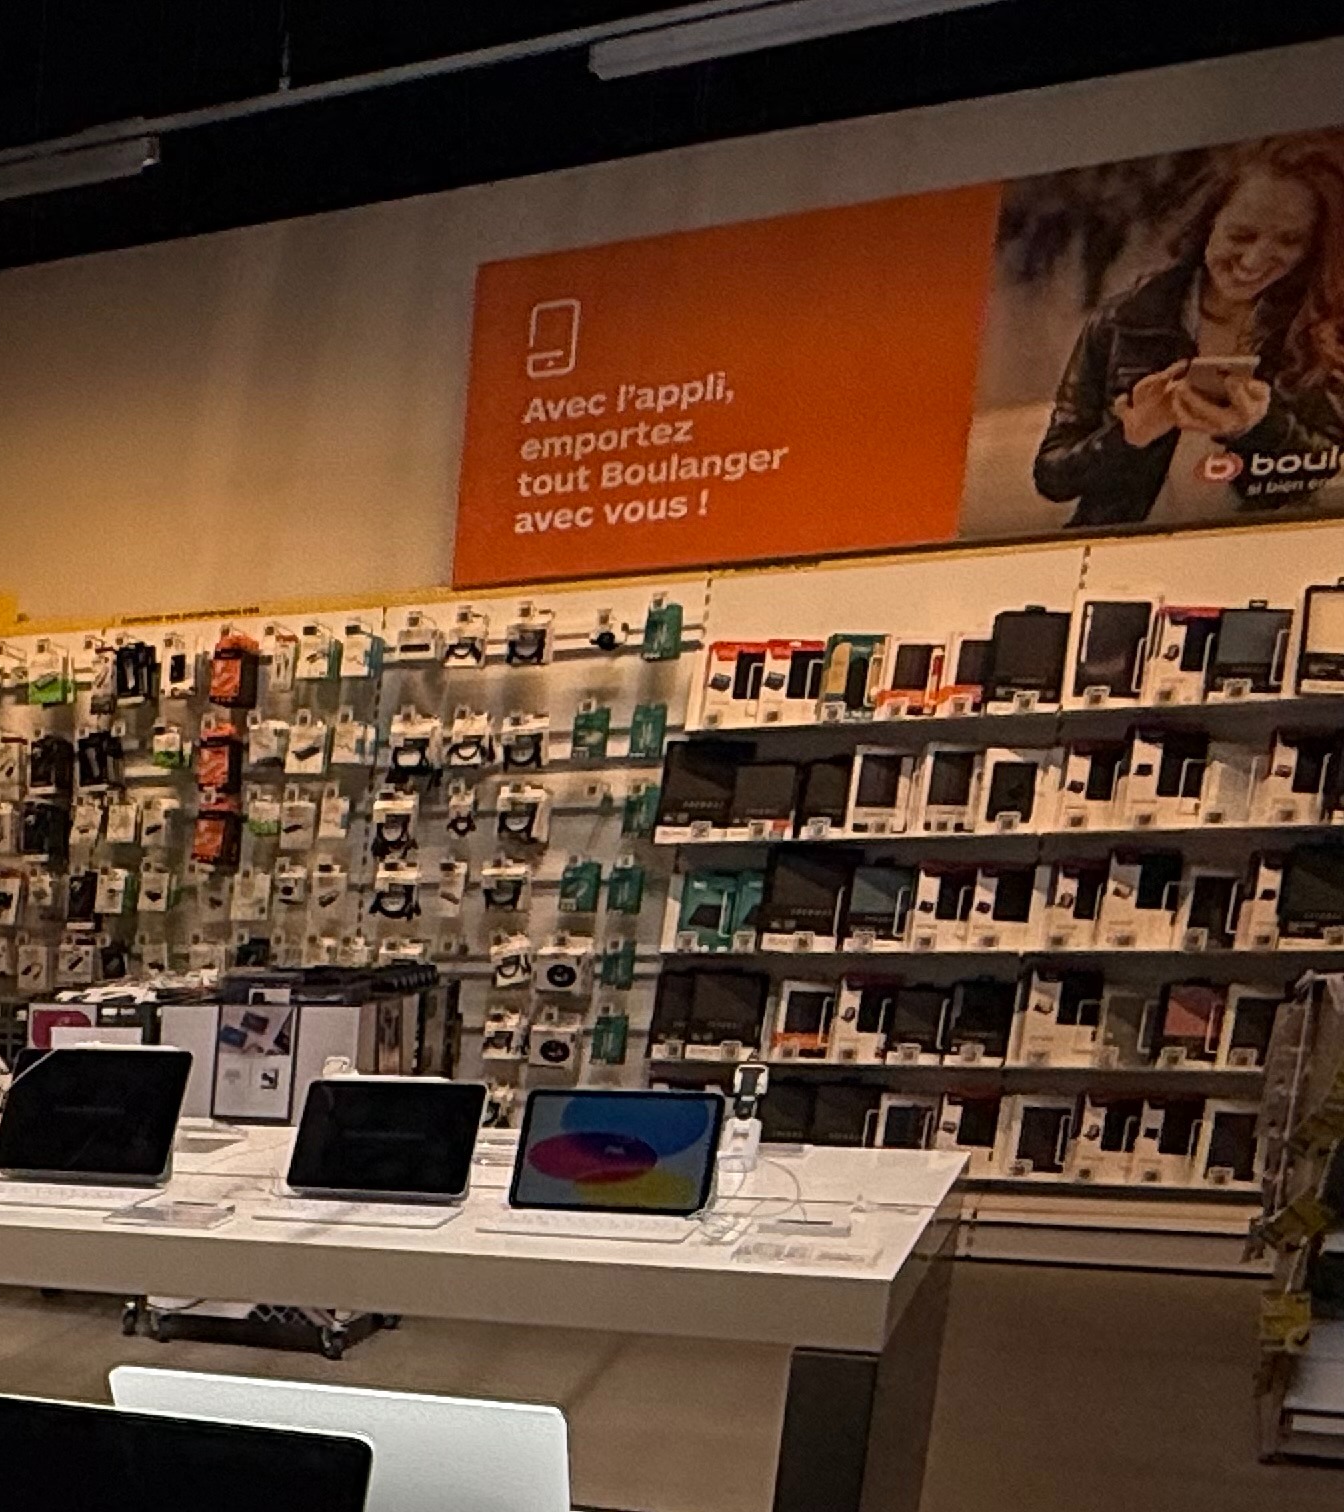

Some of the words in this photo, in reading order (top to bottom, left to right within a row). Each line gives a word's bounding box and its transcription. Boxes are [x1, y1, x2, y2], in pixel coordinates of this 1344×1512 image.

[521, 393, 606, 424] Avec
[520, 419, 693, 460] emportez
[517, 466, 590, 496] tout
[601, 447, 789, 489] Boulanger
[1250, 445, 1343, 476] boul
[514, 504, 594, 533] avec
[605, 493, 688, 524] vous
[699, 490, 709, 515] !
